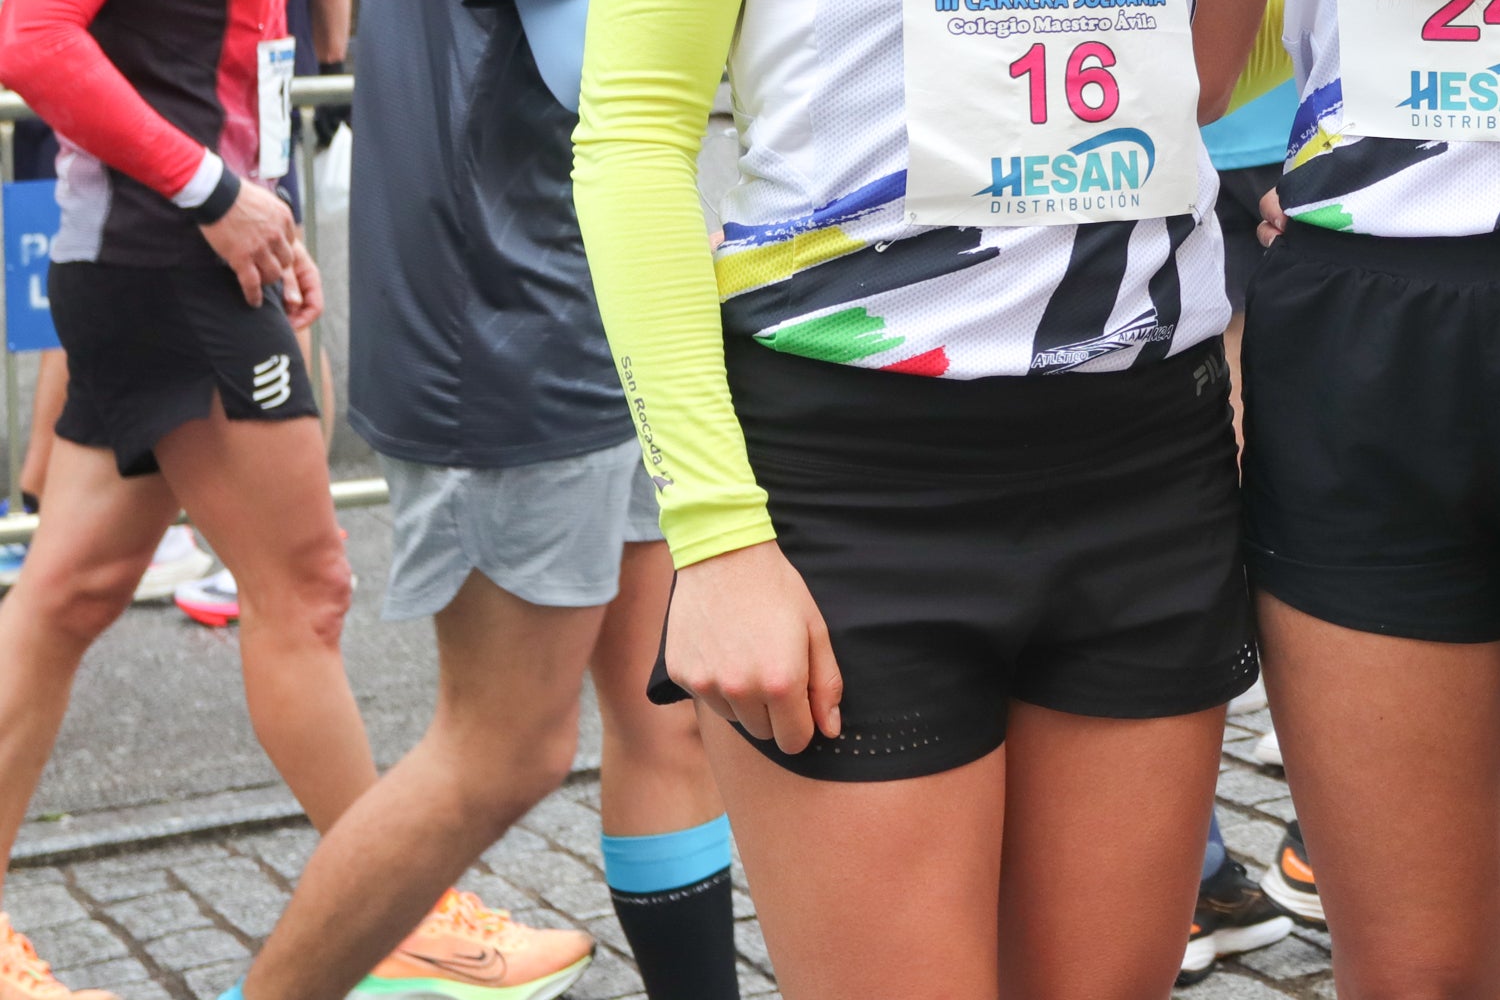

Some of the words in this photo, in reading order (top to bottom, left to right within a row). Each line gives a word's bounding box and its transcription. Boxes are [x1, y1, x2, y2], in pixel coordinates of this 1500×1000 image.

[947, 17, 1031, 39] Colegio
[1033, 16, 1113, 33] Maestro
[1115, 10, 1157, 31] Ávila
[1009, 41, 1120, 125] 16
[971, 150, 1140, 197] HESAN
[990, 192, 1140, 214] DISTRIBUCIÓN
[21, 232, 57, 266] P
[621, 356, 637, 392] San
[634, 397, 663, 466] Rocada
